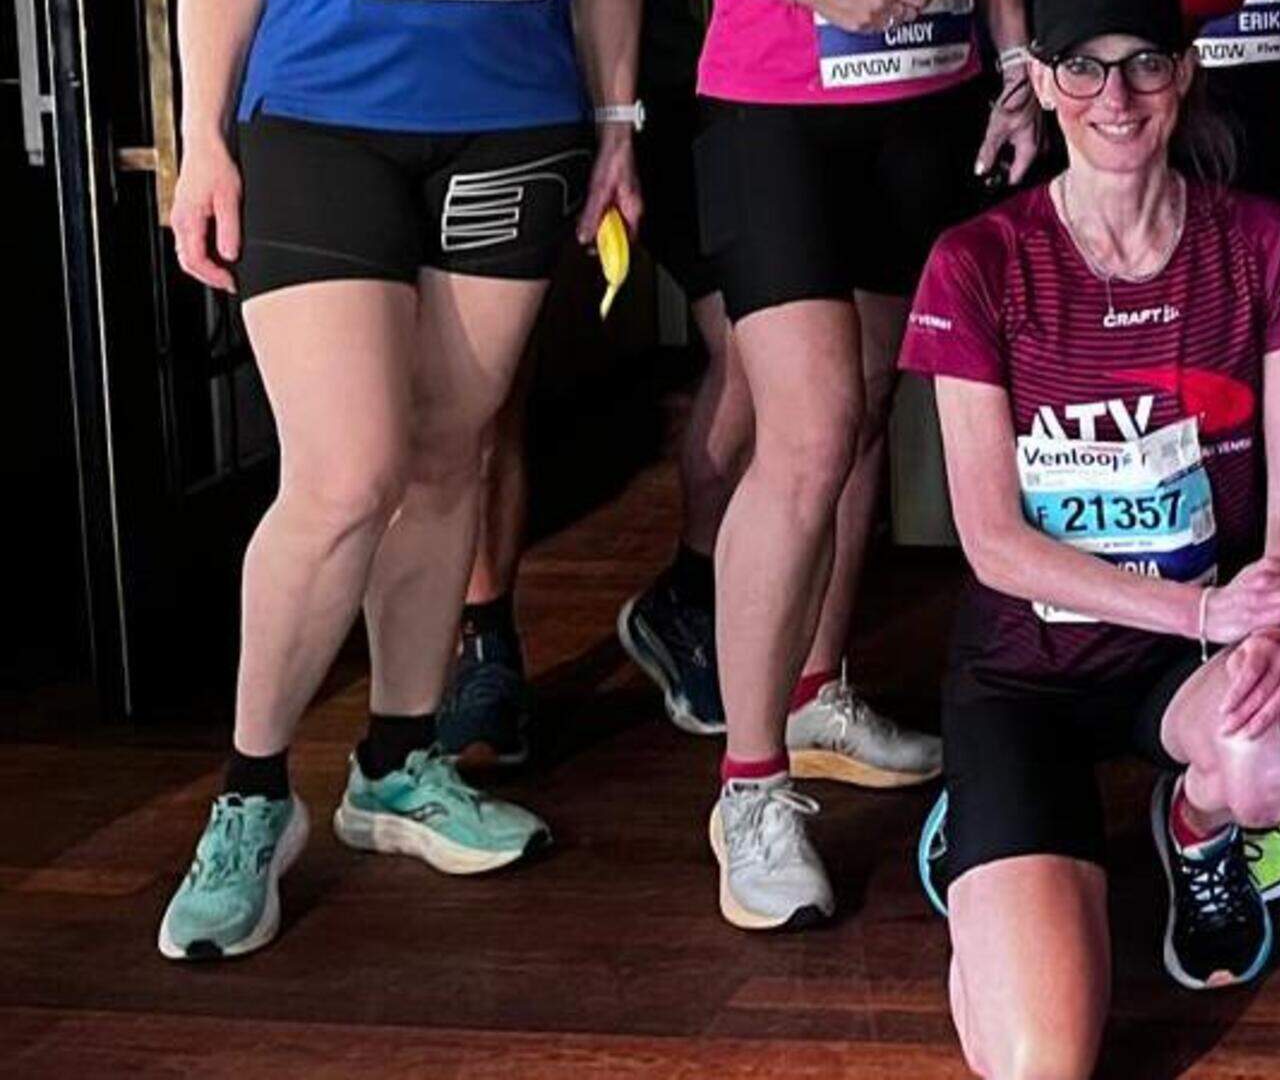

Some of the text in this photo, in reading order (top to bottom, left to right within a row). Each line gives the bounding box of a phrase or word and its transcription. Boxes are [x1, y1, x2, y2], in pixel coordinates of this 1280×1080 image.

[884, 22, 934, 47] CINDY
[1031, 395, 1155, 442] ATV
[1024, 447, 1132, 471] Venloop
[1036, 489, 1183, 532] F 21357
